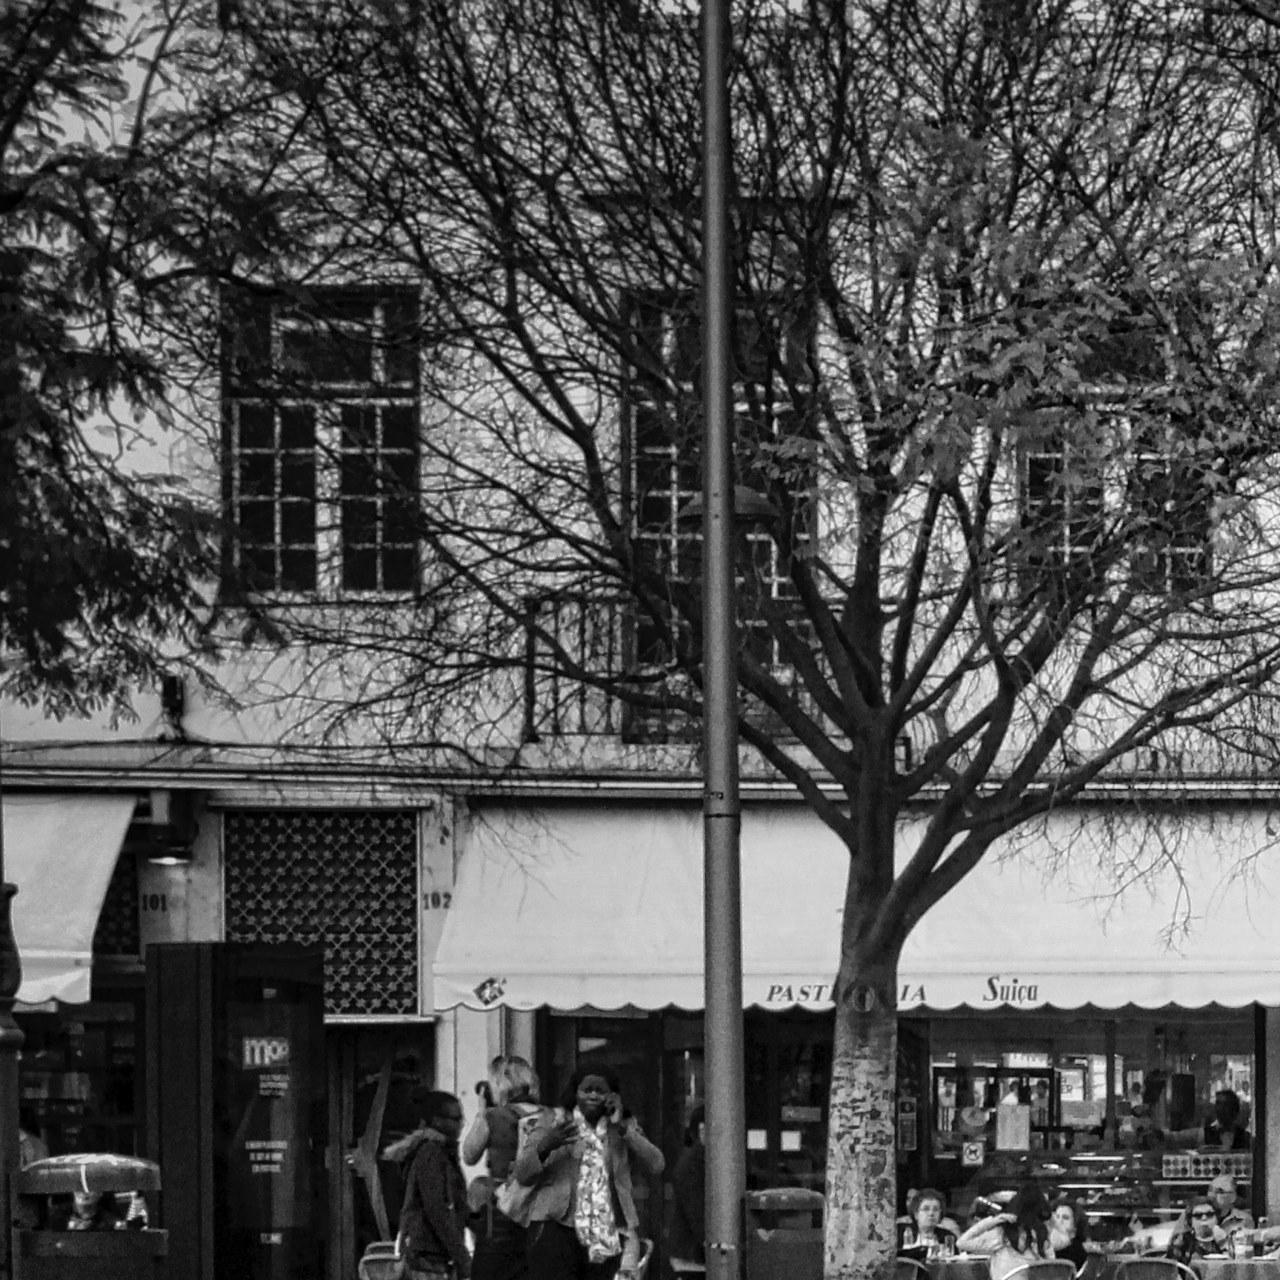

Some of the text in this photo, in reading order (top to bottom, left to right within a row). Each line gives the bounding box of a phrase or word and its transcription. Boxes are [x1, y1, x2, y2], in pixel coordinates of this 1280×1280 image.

[142, 894, 167, 912] 101
[423, 892, 451, 910] 102
[766, 984, 927, 1002] PASTIA
